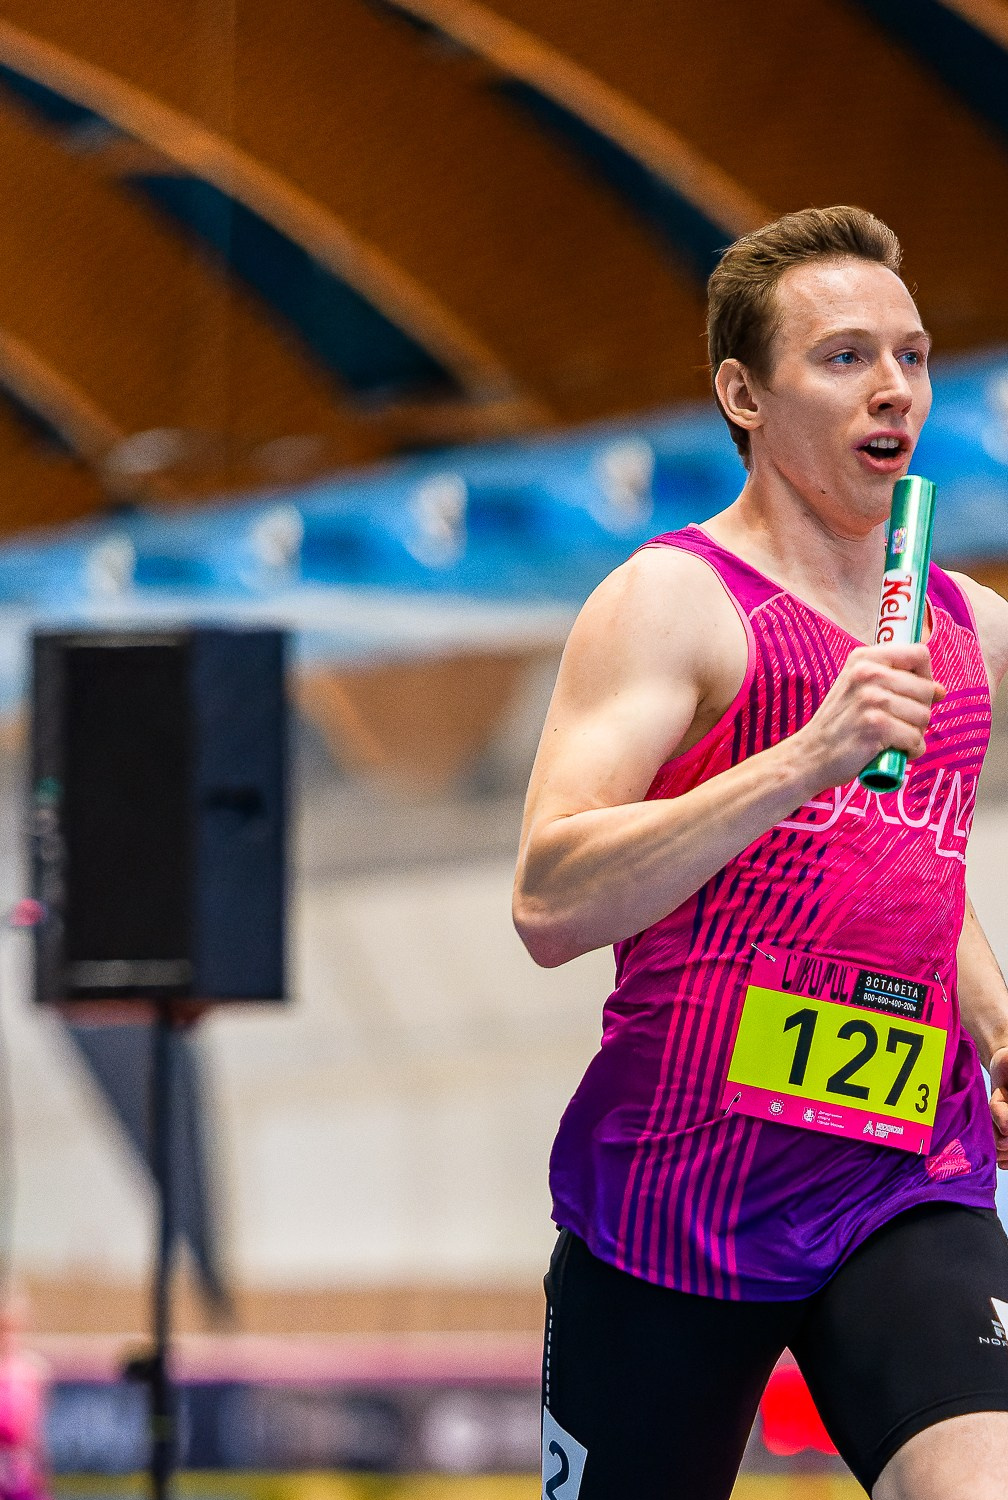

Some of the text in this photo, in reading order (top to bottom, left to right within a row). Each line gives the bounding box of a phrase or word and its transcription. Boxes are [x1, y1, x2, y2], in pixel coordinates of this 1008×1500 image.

[865, 976, 919, 998] ЭСТАФЕТА
[783, 1008, 924, 1107] 127
[914, 1083, 930, 1114] 3
